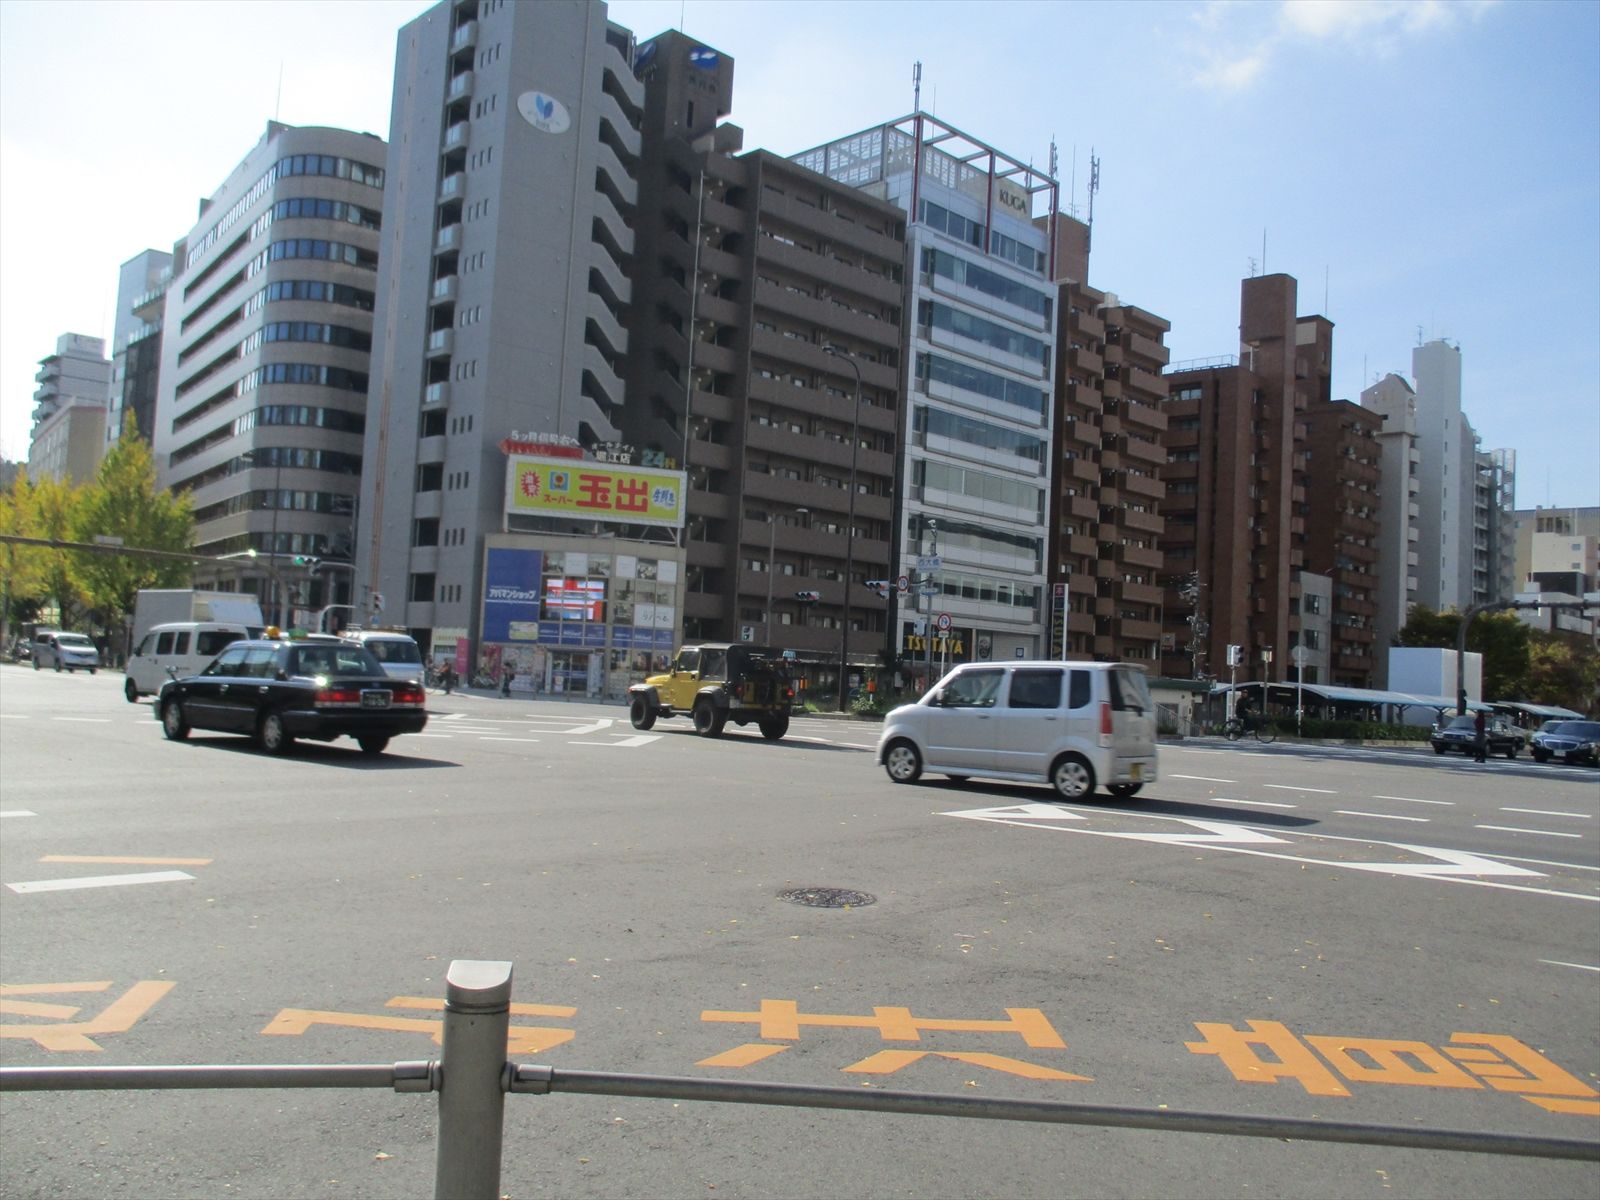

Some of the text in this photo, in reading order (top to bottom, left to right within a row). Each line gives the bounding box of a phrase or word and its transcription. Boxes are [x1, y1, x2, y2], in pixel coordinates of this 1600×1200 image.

[999, 189, 1027, 213] KUGA
[543, 493, 573, 504] スーパー
[576, 474, 648, 513] 玉出
